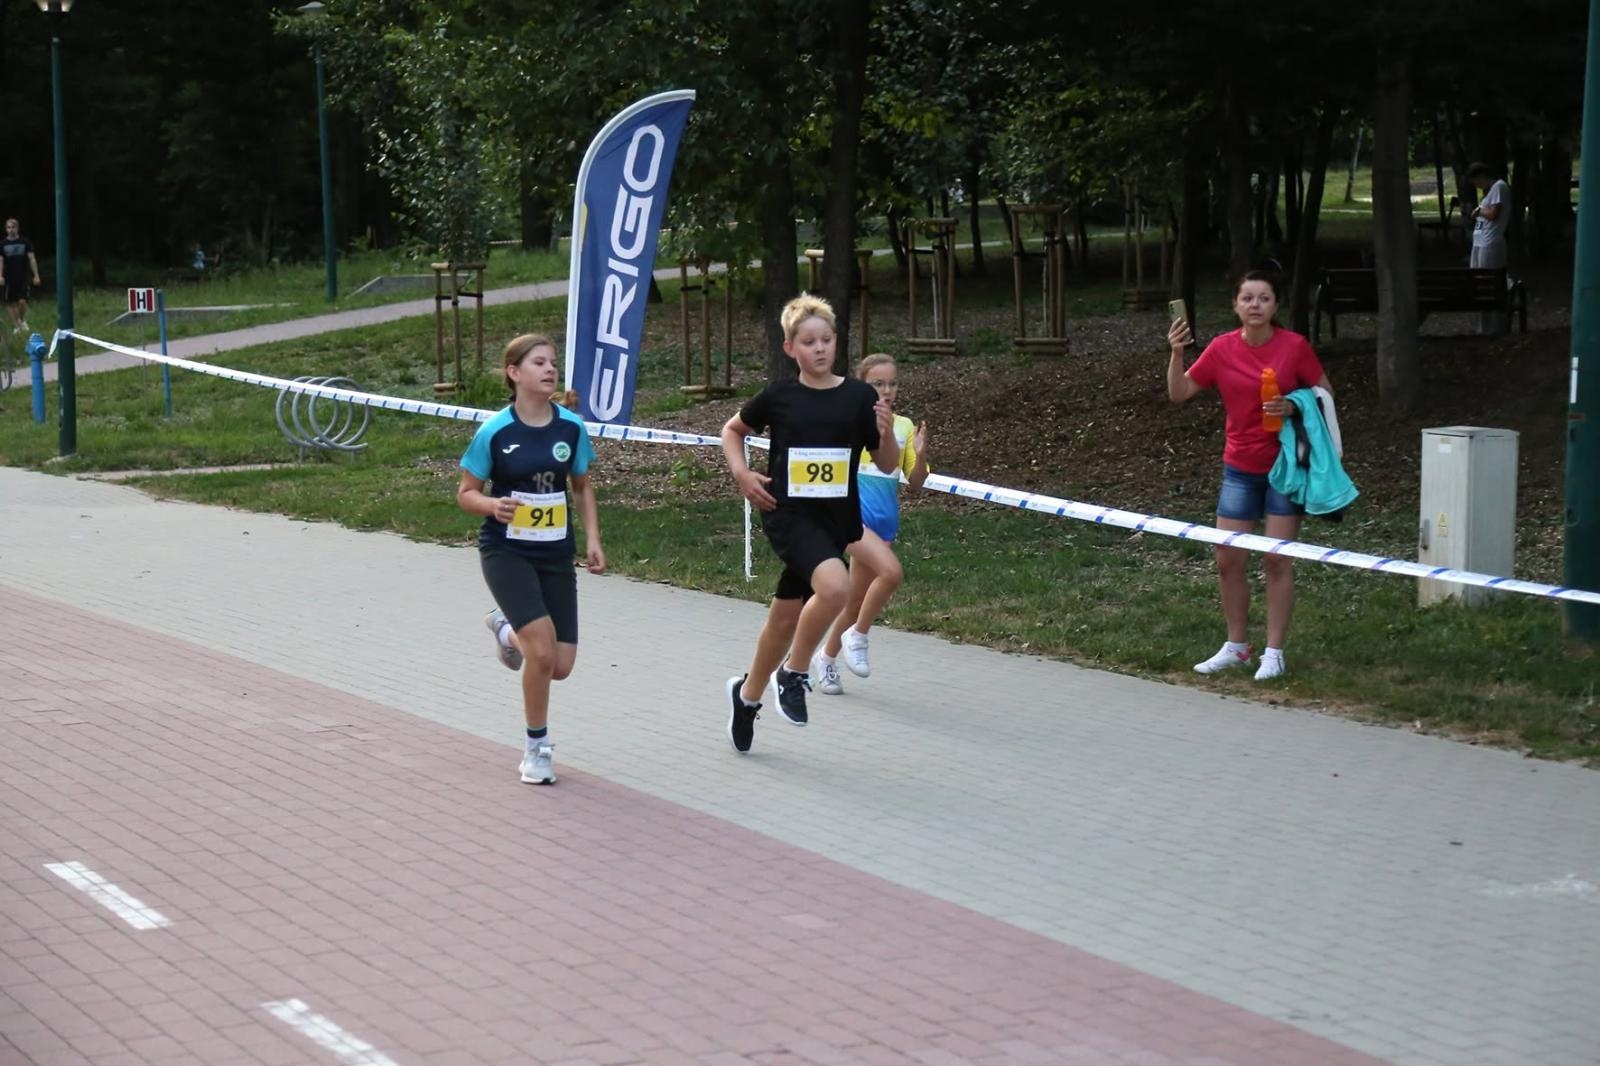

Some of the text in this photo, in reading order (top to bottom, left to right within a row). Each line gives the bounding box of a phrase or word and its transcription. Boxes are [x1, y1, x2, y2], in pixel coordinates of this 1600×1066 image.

[589, 124, 665, 422] ERIGO
[136, 291, 146, 309] H
[806, 462, 834, 483] 98
[530, 507, 555, 527] 91
